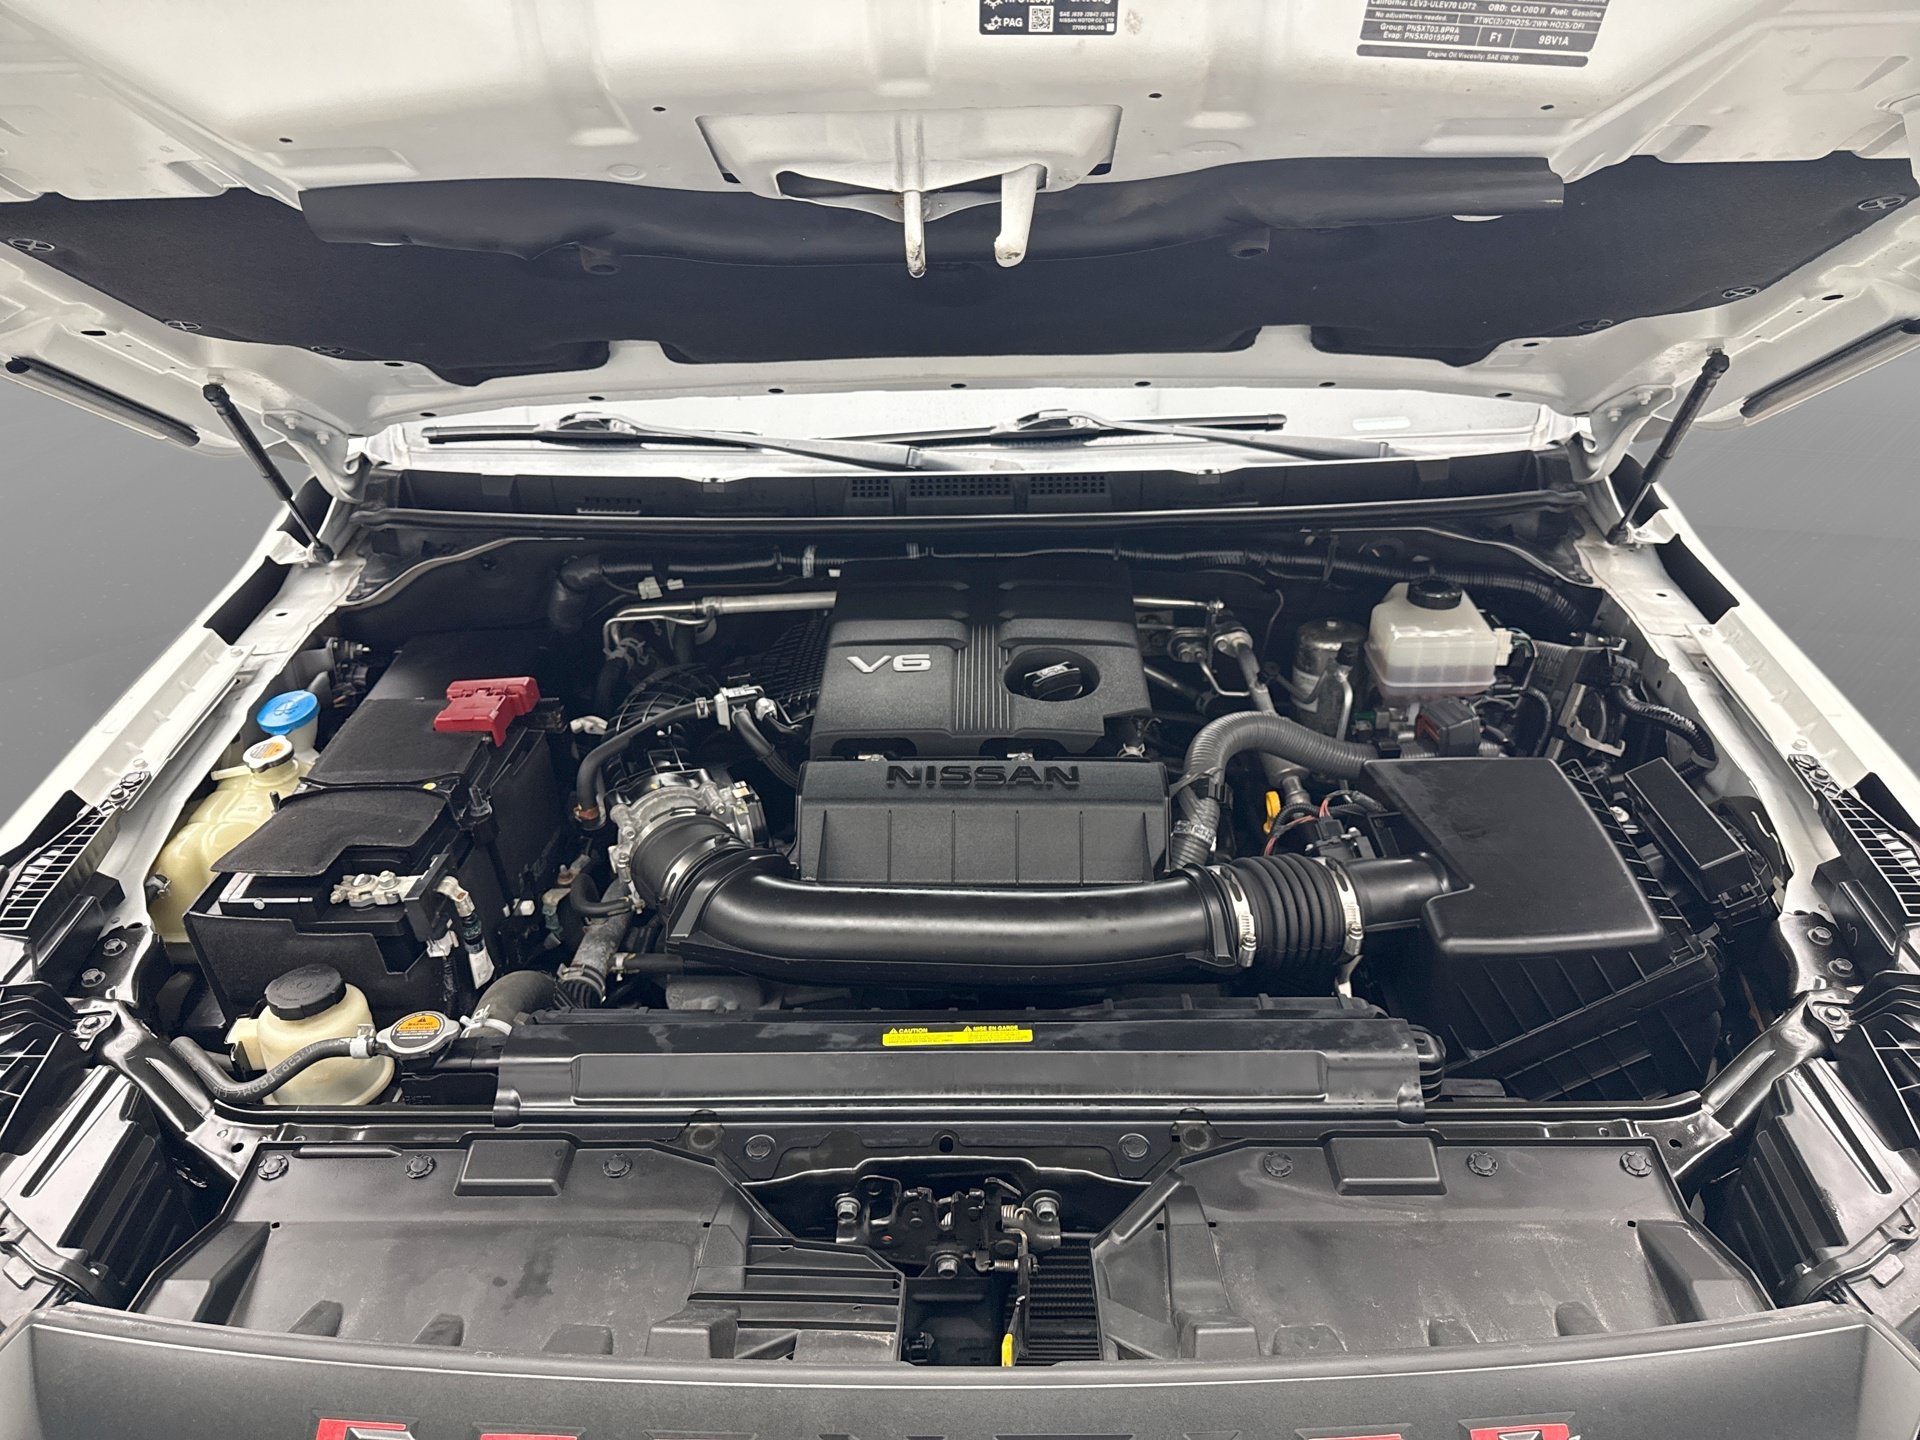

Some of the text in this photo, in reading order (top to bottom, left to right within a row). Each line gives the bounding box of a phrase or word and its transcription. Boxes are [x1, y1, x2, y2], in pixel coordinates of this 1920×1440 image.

[1458, 2, 1477, 10] LDT2
[1488, 3, 1508, 12] OBD:
[1511, 4, 1521, 13] CA
[1523, 5, 1540, 14] OBD
[1385, 11, 1423, 20] adjustments
[1550, 7, 1602, 18] Fuel: Gasoline
[1003, 17, 1023, 28] PAG
[1380, 22, 1405, 32] Group:
[1383, 30, 1402, 40] Evap:
[1489, 32, 1502, 43] F1
[1538, 35, 1569, 46] 9BV1A
[1427, 50, 1448, 58] Engine
[1486, 53, 1499, 61] SAE
[847, 653, 932, 674] V6
[886, 765, 1080, 787] NISSAN
